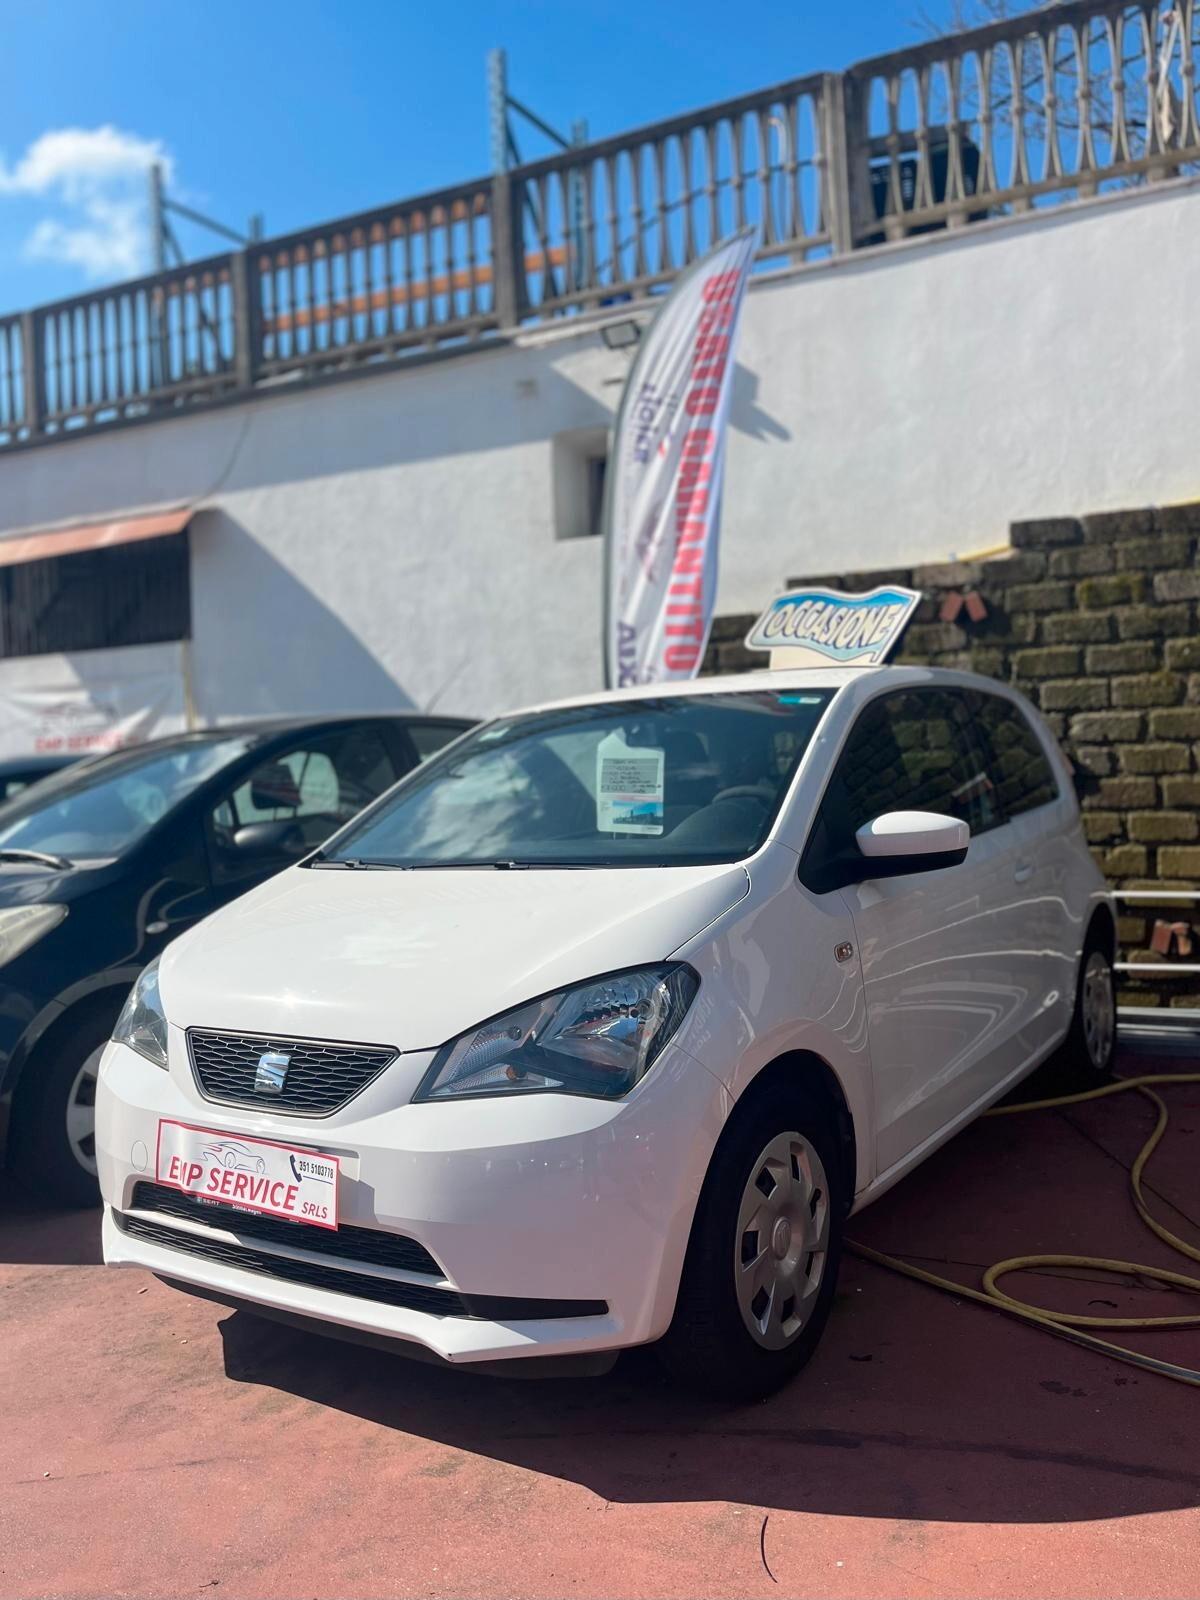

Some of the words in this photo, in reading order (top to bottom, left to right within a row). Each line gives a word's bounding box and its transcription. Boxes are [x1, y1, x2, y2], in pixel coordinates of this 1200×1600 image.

[684, 268, 741, 417] USATO
[663, 427, 716, 672] GARANTITO
[206, 1166, 299, 1211] SERVICE
[301, 1201, 328, 1219] SRLS
[299, 1160, 310, 1173] 351
